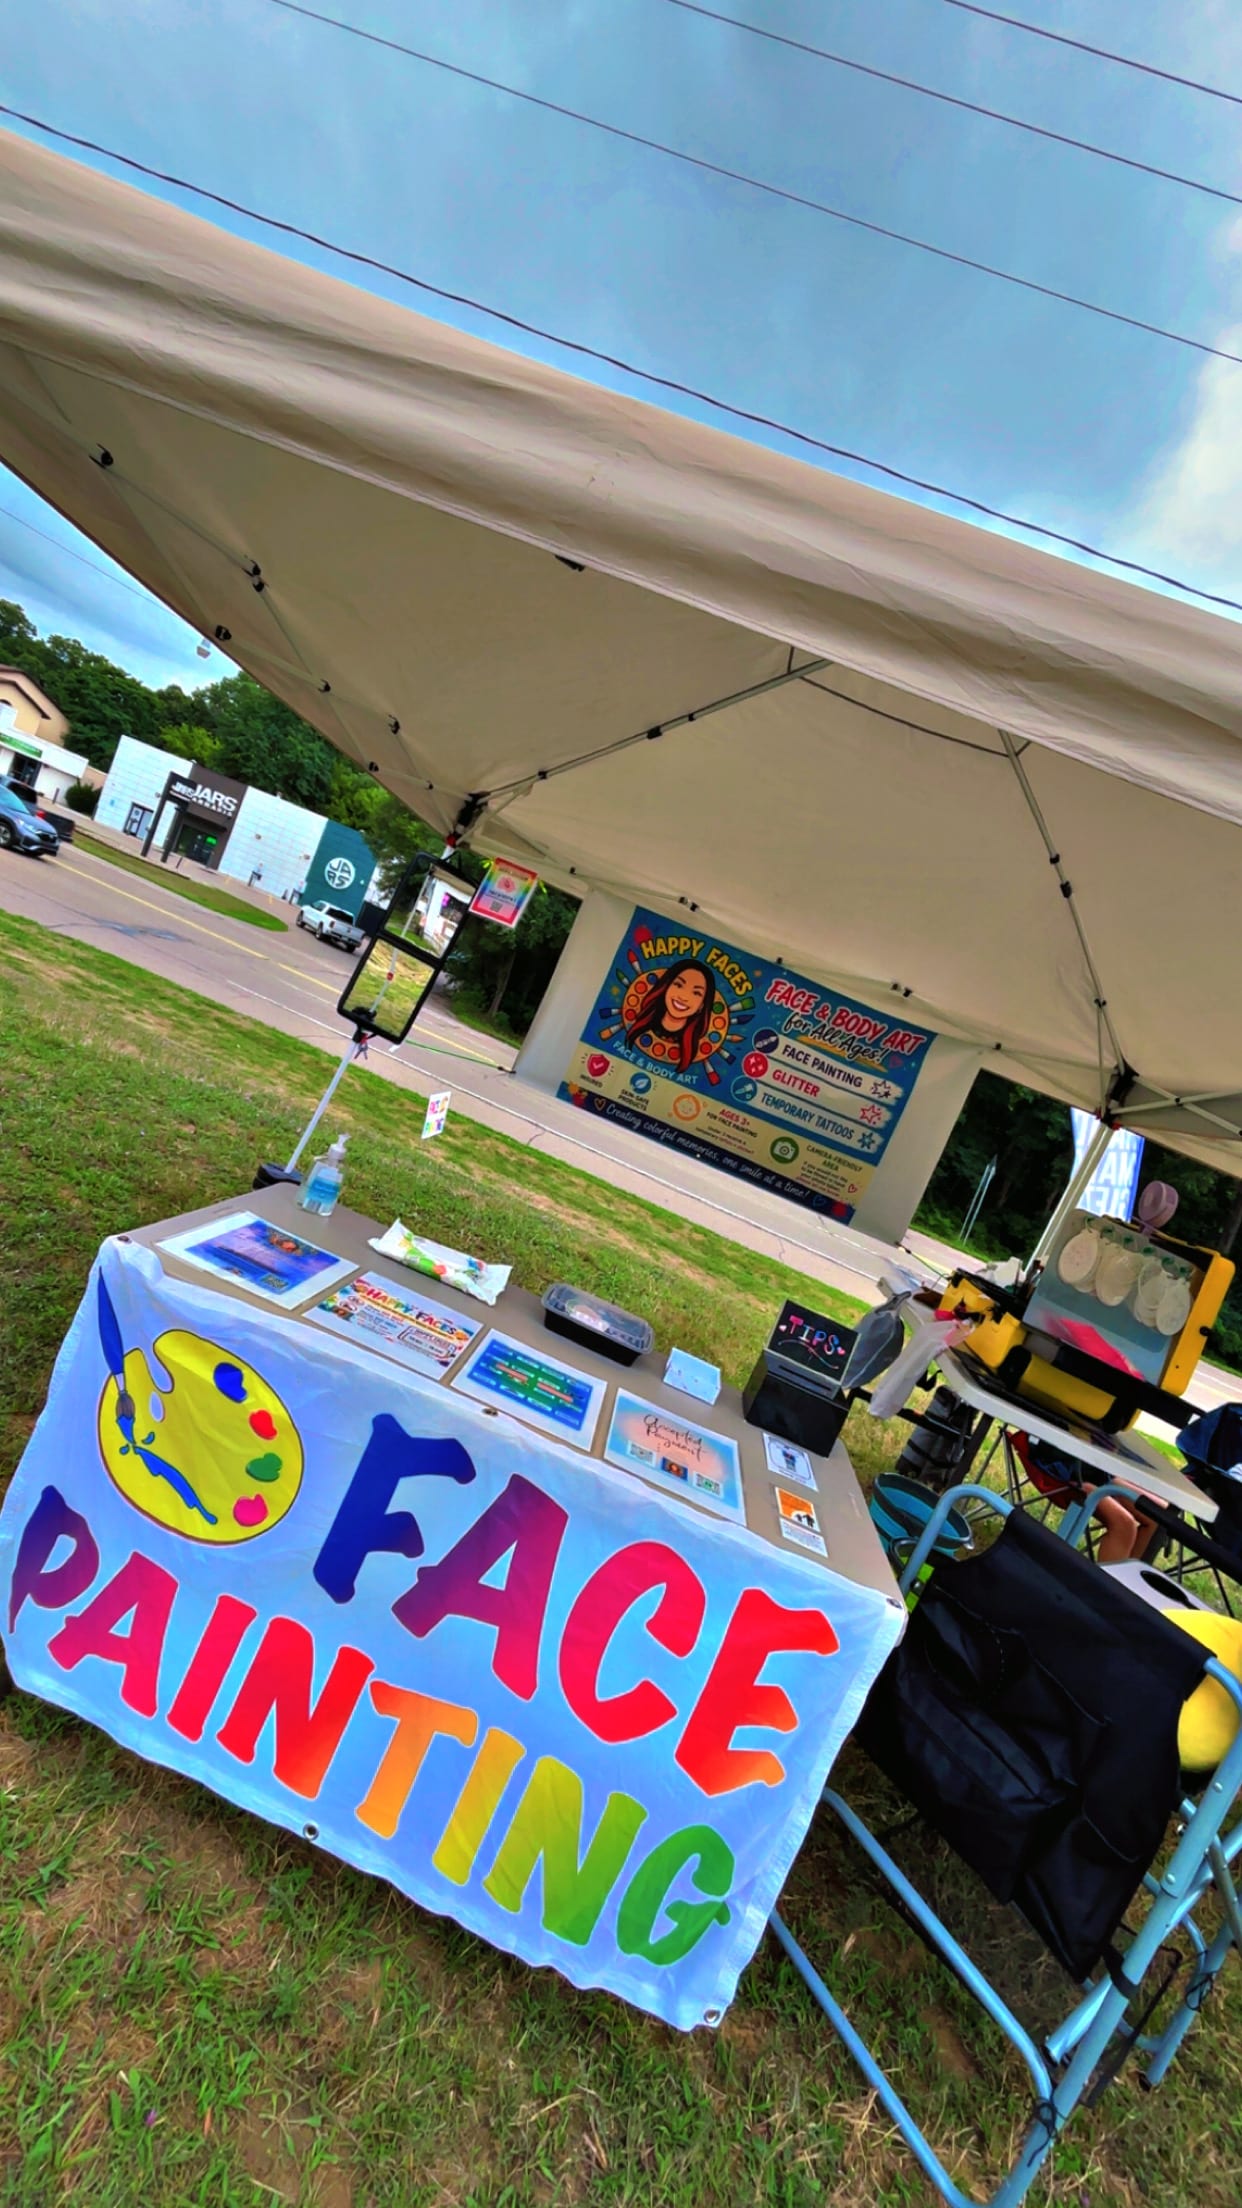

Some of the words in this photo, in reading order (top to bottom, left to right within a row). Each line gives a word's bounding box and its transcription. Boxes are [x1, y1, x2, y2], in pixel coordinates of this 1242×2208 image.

[194, 784, 239, 812] JARS
[640, 936, 705, 959] HAPPY
[706, 947, 753, 996] FACES
[765, 978, 819, 1014] FACE
[815, 1003, 832, 1022] &
[831, 1007, 887, 1041] BODY
[882, 1029, 927, 1056] ART
[783, 1012, 811, 1033] for
[811, 1023, 840, 1046] All
[839, 1033, 889, 1064] Ages!
[613, 1041, 636, 1059] FACE
[636, 1057, 644, 1067] &
[646, 1062, 675, 1079] BODY
[676, 1073, 698, 1085] ART
[772, 1069, 820, 1098] GLITTER
[782, 1044, 810, 1066] FACE
[811, 1059, 863, 1088] PAINTING
[618, 1094, 648, 1112] PRODUCTS
[706, 1111, 718, 1121] FOR
[718, 1116, 732, 1128] FACE
[732, 1124, 758, 1138] PAINTING
[719, 1108, 740, 1122] AGES
[761, 1092, 815, 1123] TEMPORARY
[815, 1116, 855, 1140] TATTOOS
[606, 1103, 642, 1129] Creating
[643, 1119, 675, 1141] colorful
[722, 1155, 738, 1169] one
[739, 1162, 763, 1180] smile
[763, 1174, 775, 1185] at
[783, 1181, 810, 1199] time!
[366, 1288, 415, 1314] HAPPY
[415, 1310, 457, 1336] FACES
[788, 1314, 840, 1356] TIPS
[643, 1414, 702, 1446] Accepted
[312, 1412, 841, 1798] FACE
[8, 1485, 737, 1967] PAINTING
